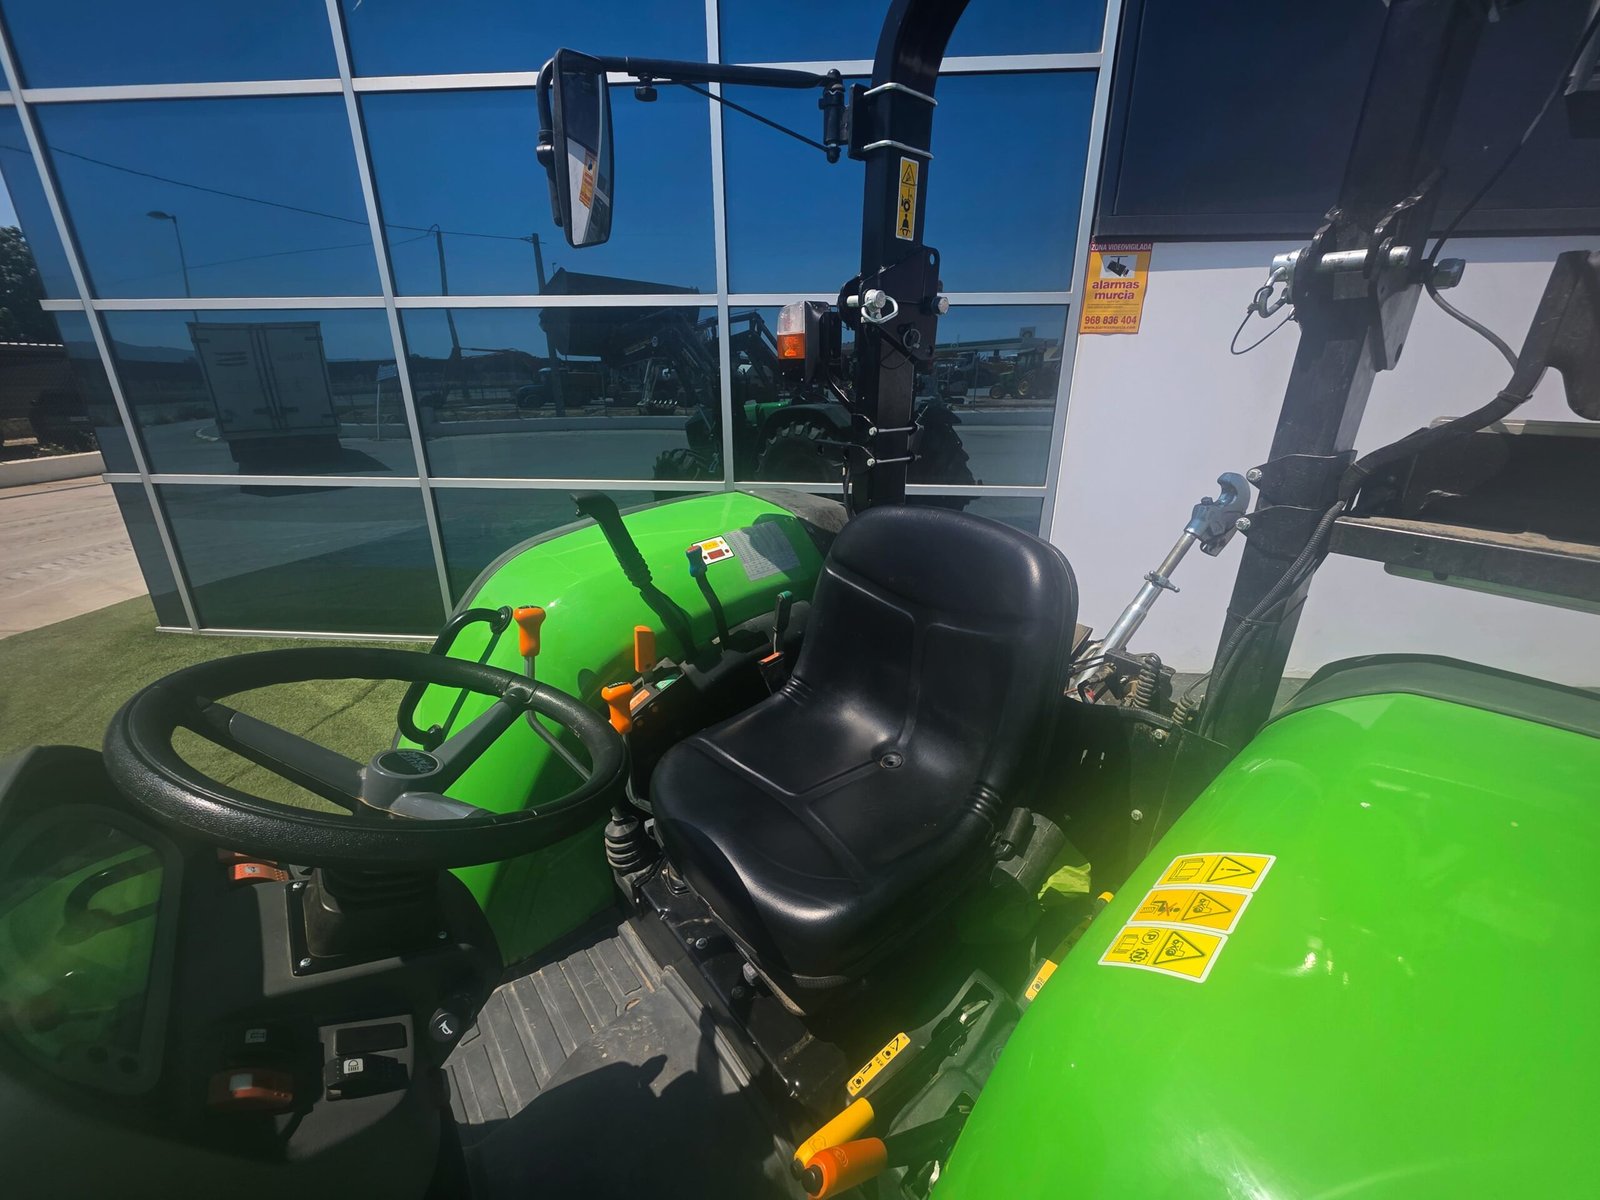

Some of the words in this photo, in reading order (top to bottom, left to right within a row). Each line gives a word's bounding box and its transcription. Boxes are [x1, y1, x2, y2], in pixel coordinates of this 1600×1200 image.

[1091, 243, 1107, 251] ZONA
[1108, 243, 1152, 251] VIDEOVIGILADA
[1092, 280, 1140, 290] alarmas
[1094, 290, 1135, 300] murcia
[1085, 316, 1101, 325] 968
[1103, 316, 1118, 325] 836
[1121, 316, 1137, 325] 404
